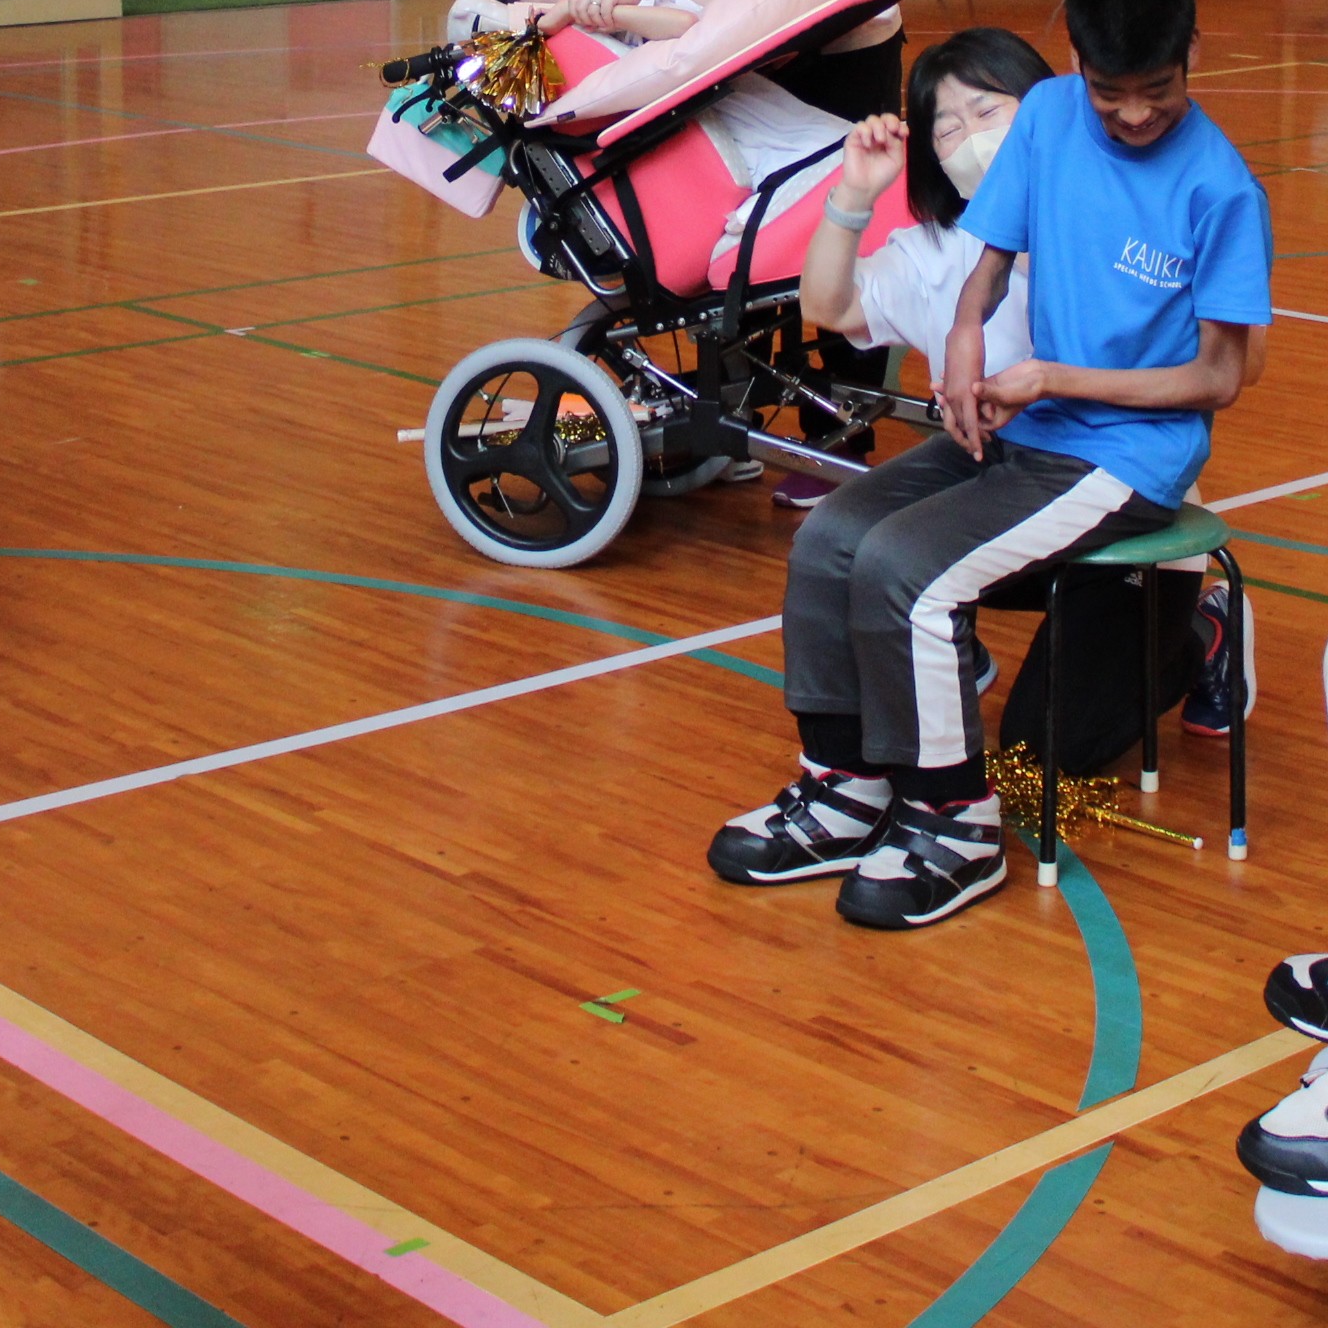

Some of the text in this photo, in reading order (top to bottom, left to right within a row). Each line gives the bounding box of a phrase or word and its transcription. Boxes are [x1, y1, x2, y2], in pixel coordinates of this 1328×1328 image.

[1120, 236, 1183, 278] KAJIKI
[1113, 262, 1183, 289] SPECIAL NEEDS SCHOOL
